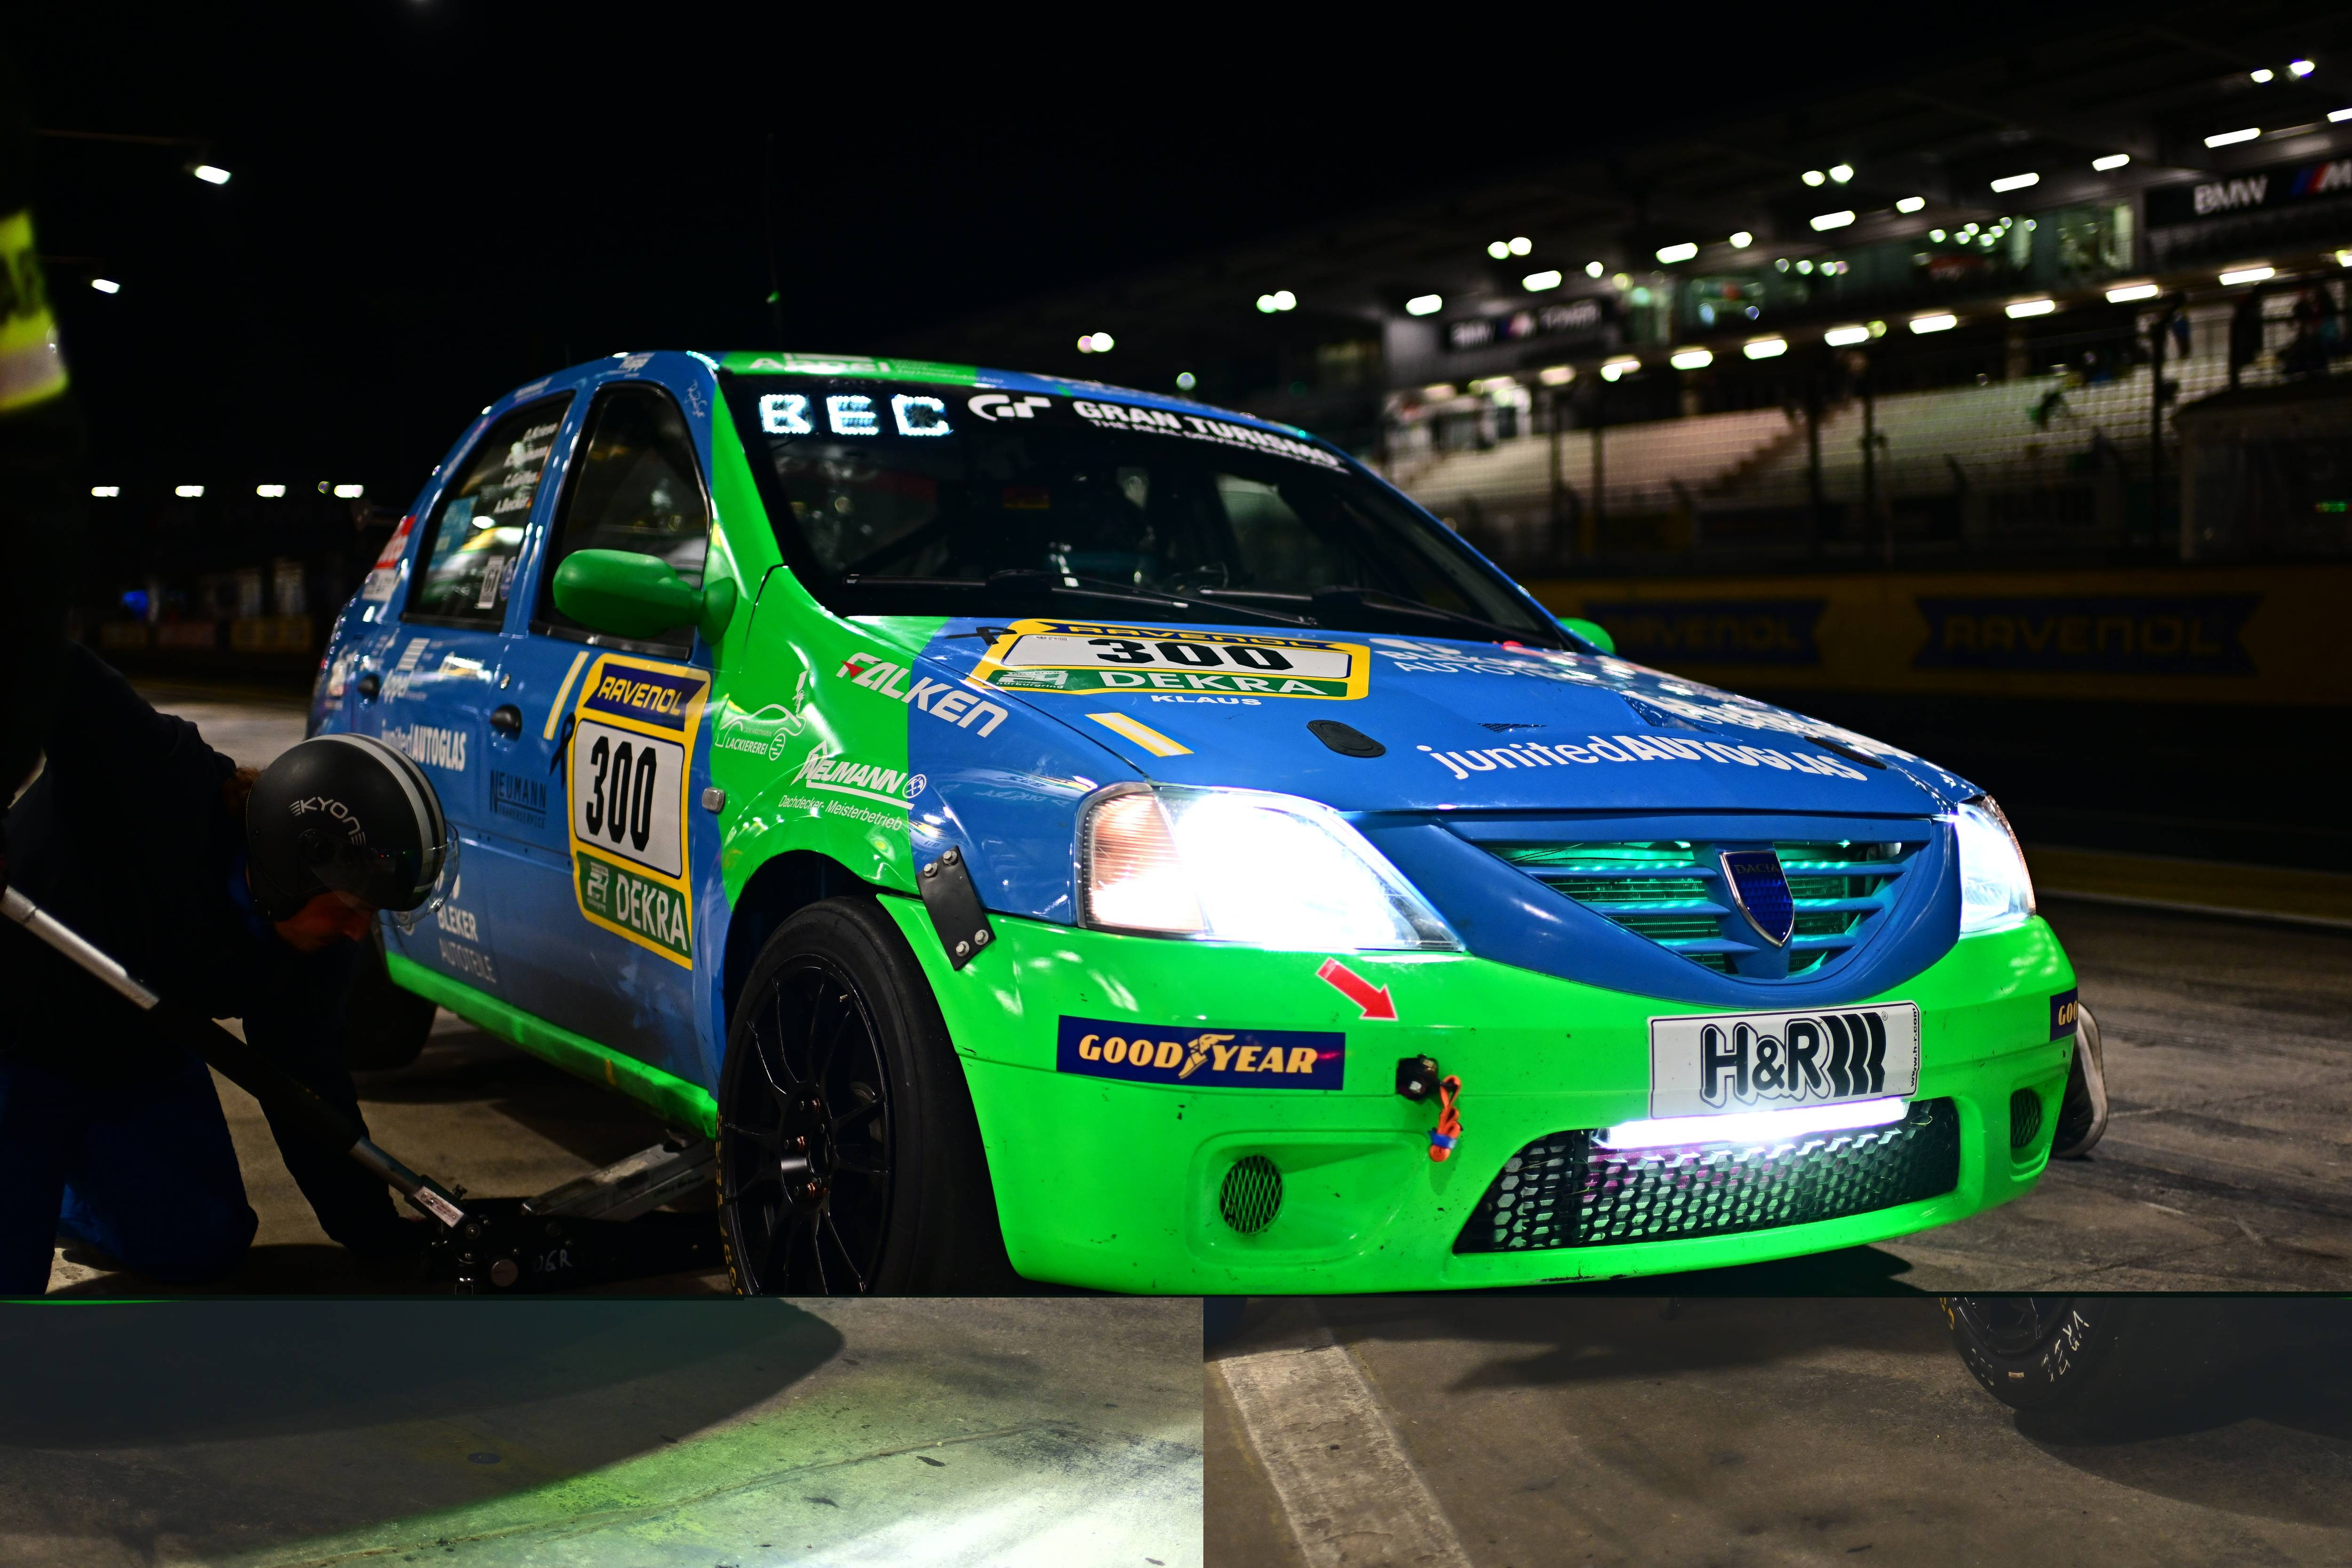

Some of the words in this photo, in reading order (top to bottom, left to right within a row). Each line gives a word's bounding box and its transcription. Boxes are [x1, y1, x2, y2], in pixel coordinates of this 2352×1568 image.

[2194, 175, 2268, 215] BMW
[1073, 401, 1182, 430] GRAN
[1183, 416, 1339, 467] TURISMO
[1068, 626, 1327, 647] RAVENOL
[1088, 638, 1294, 670] 300
[1943, 616, 2222, 654] RAVENOL
[597, 675, 683, 716] RAVENOL
[836, 652, 1009, 738] FALKEN
[1099, 671, 1328, 695] DEKRA
[1151, 695, 1262, 706] KLAUS
[725, 737, 769, 756] LACKIEREREI
[1417, 734, 1868, 781] junitedAUTOGLAS
[490, 770, 548, 814] NEUMANN
[795, 753, 907, 794] NEUMANN
[586, 736, 657, 852] 300
[825, 800, 903, 831] Meisterbetrieb
[1734, 863, 1780, 874] DACIA
[437, 904, 479, 942] BLEKER
[616, 873, 688, 951] DEKRA
[1701, 1017, 1830, 1109] H&R
[1911, 1008, 1919, 1089] www.h-r.com
